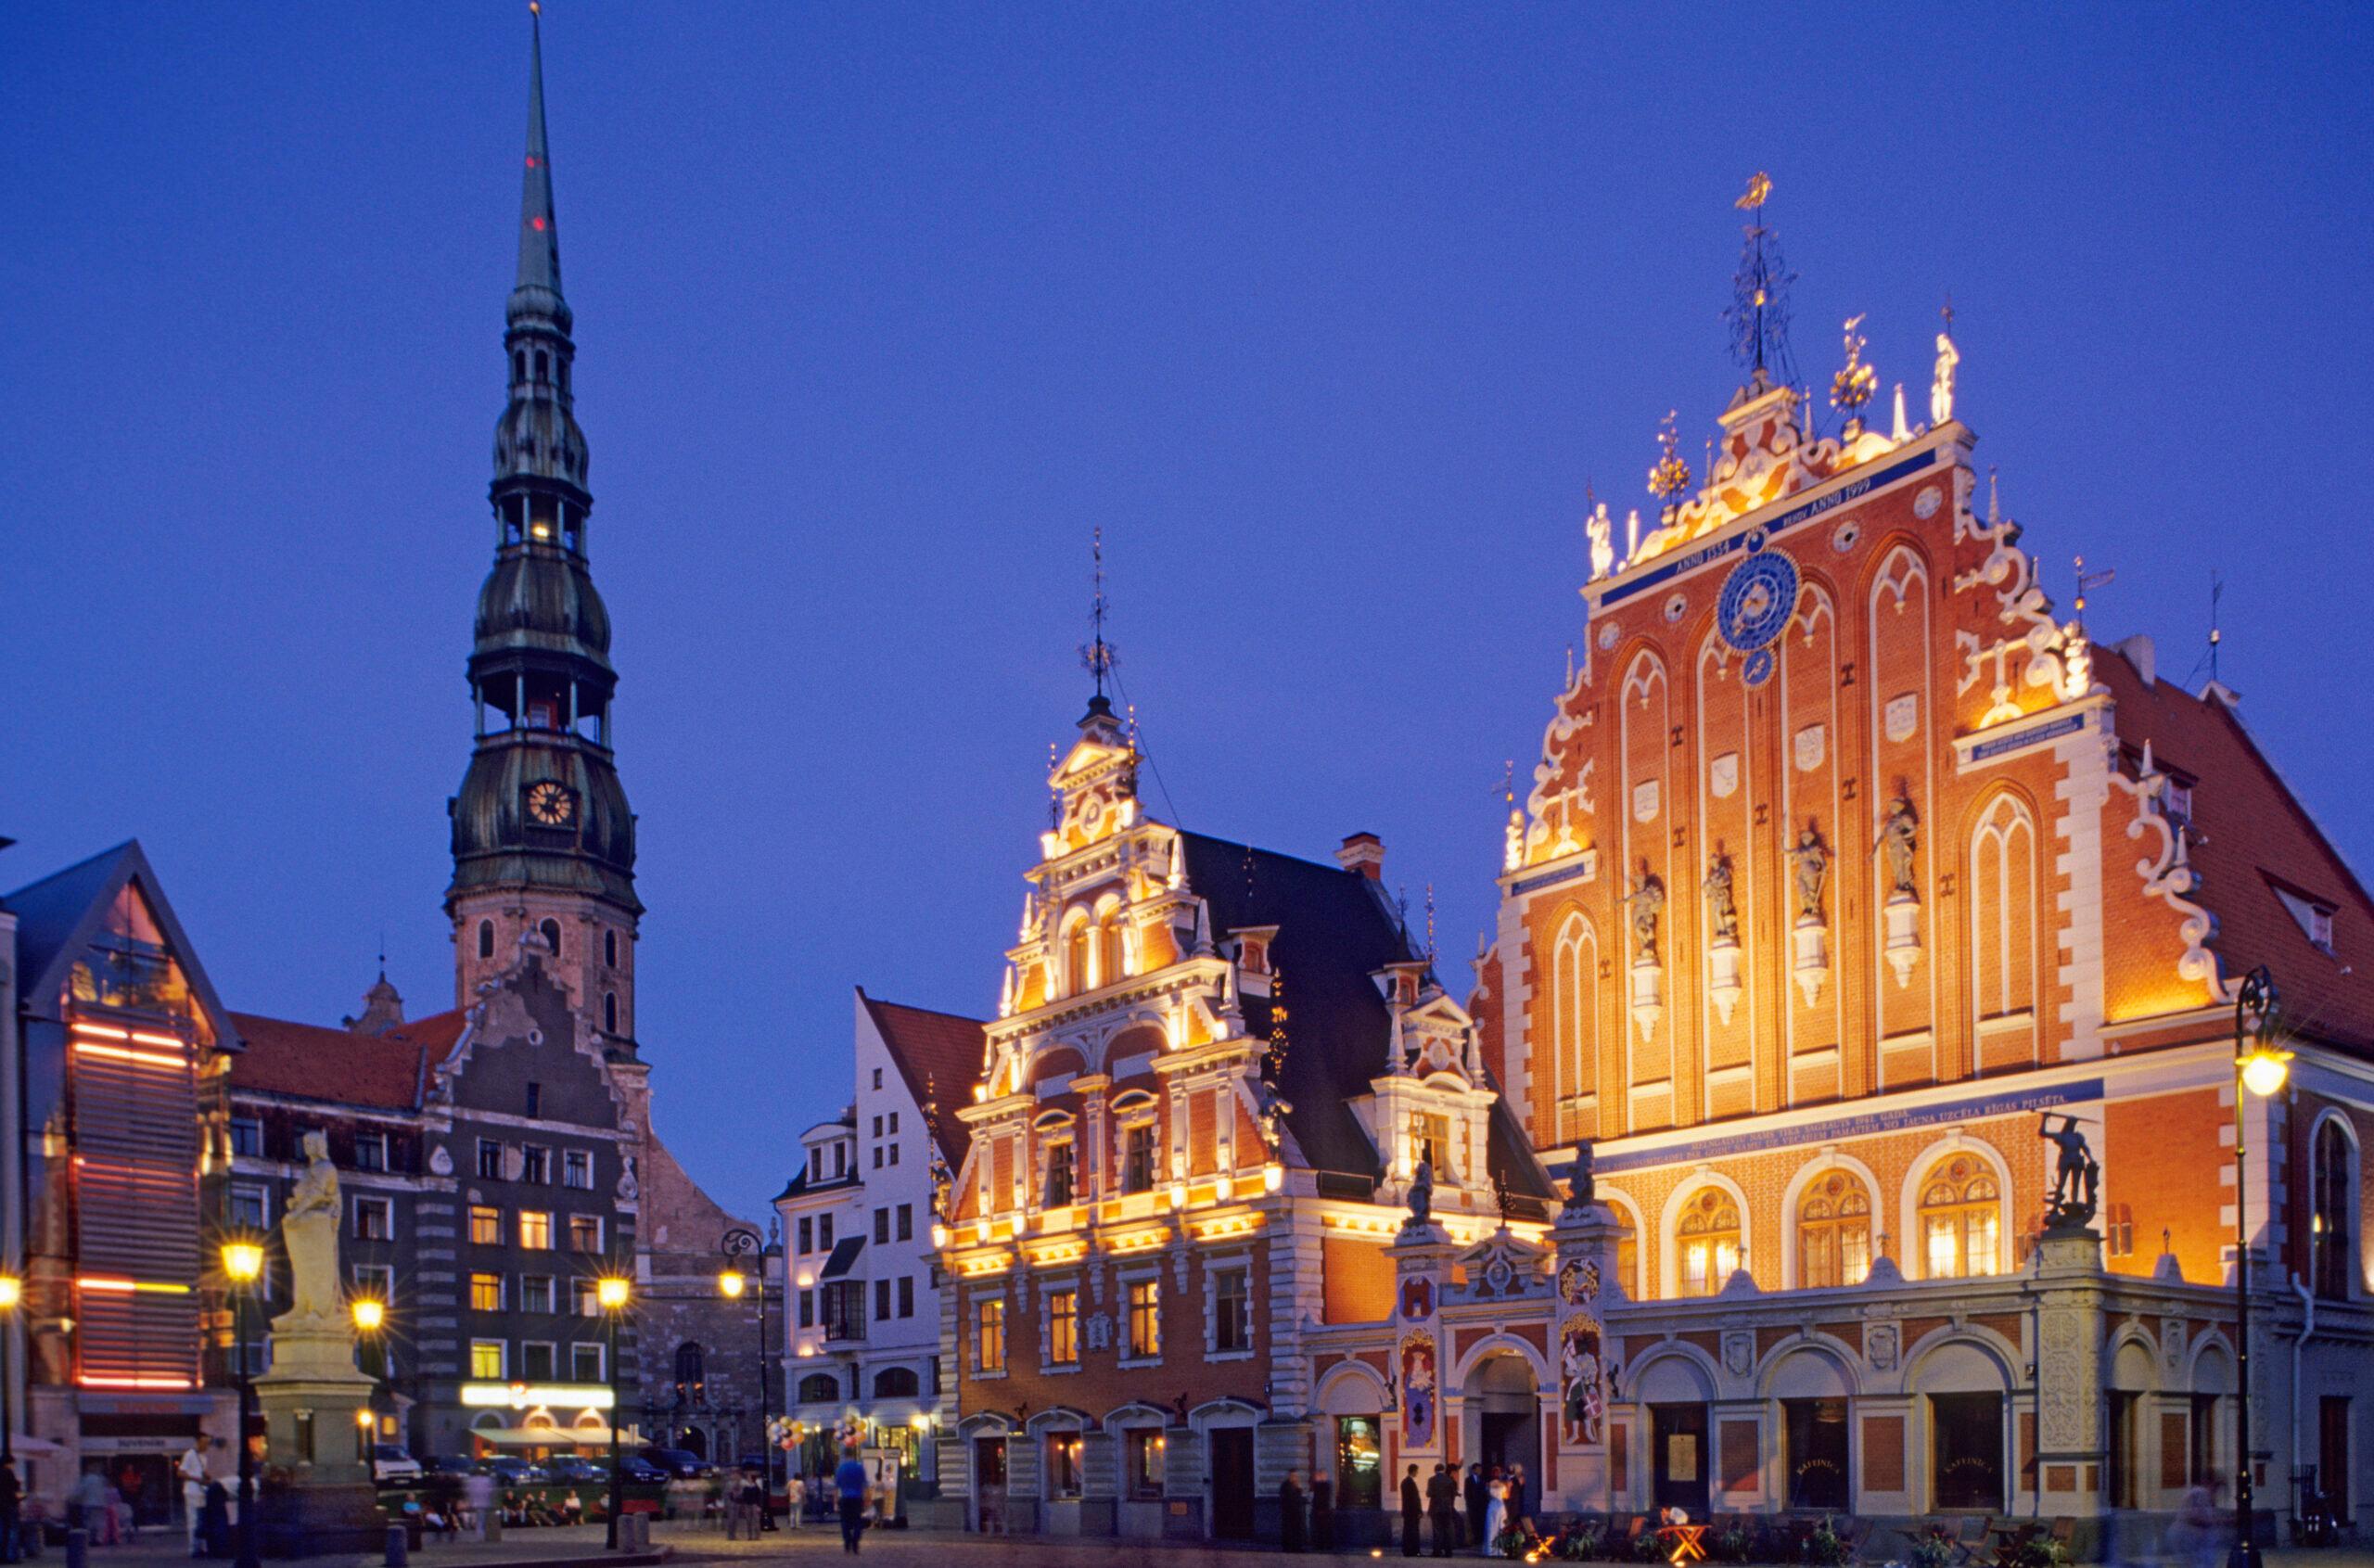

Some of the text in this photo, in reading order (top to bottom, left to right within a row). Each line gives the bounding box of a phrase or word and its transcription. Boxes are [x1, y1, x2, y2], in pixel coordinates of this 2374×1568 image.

[1810, 491, 1842, 516] ANNO
[1844, 478, 1870, 501] 1999
[1676, 551, 1704, 574] ANNO
[1883, 1118, 1898, 1129] NO
[1903, 1115, 1935, 1128] JAUNA
[1985, 1102, 2017, 1115] RĪGAS
